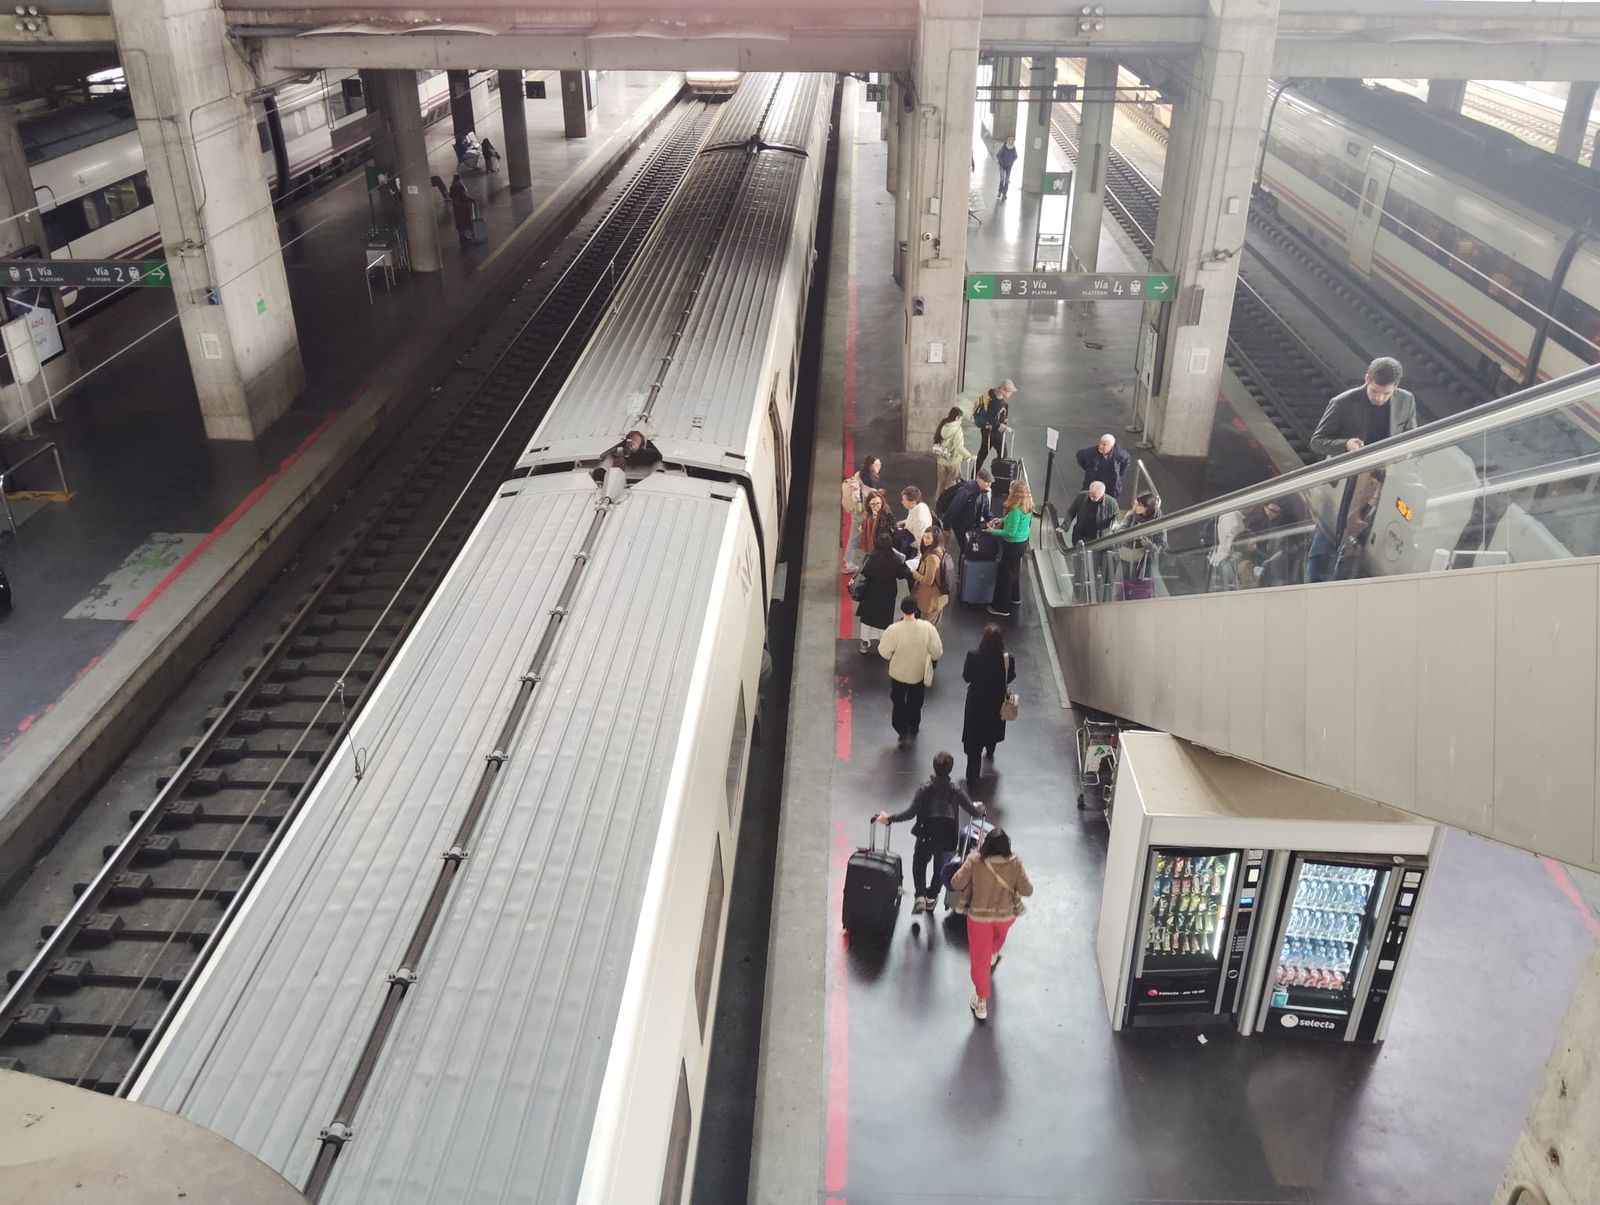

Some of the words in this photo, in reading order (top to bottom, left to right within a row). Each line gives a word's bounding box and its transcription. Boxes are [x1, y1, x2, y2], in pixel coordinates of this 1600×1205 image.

[25, 267, 37, 282] 1
[94, 266, 110, 276] Vía
[113, 267, 125, 282] 2
[1018, 280, 1028, 295] 3
[1032, 279, 1047, 289] Vía
[1094, 279, 1109, 289] Vía
[1113, 280, 1124, 296] 4
[1299, 1019, 1336, 1030] selecta
